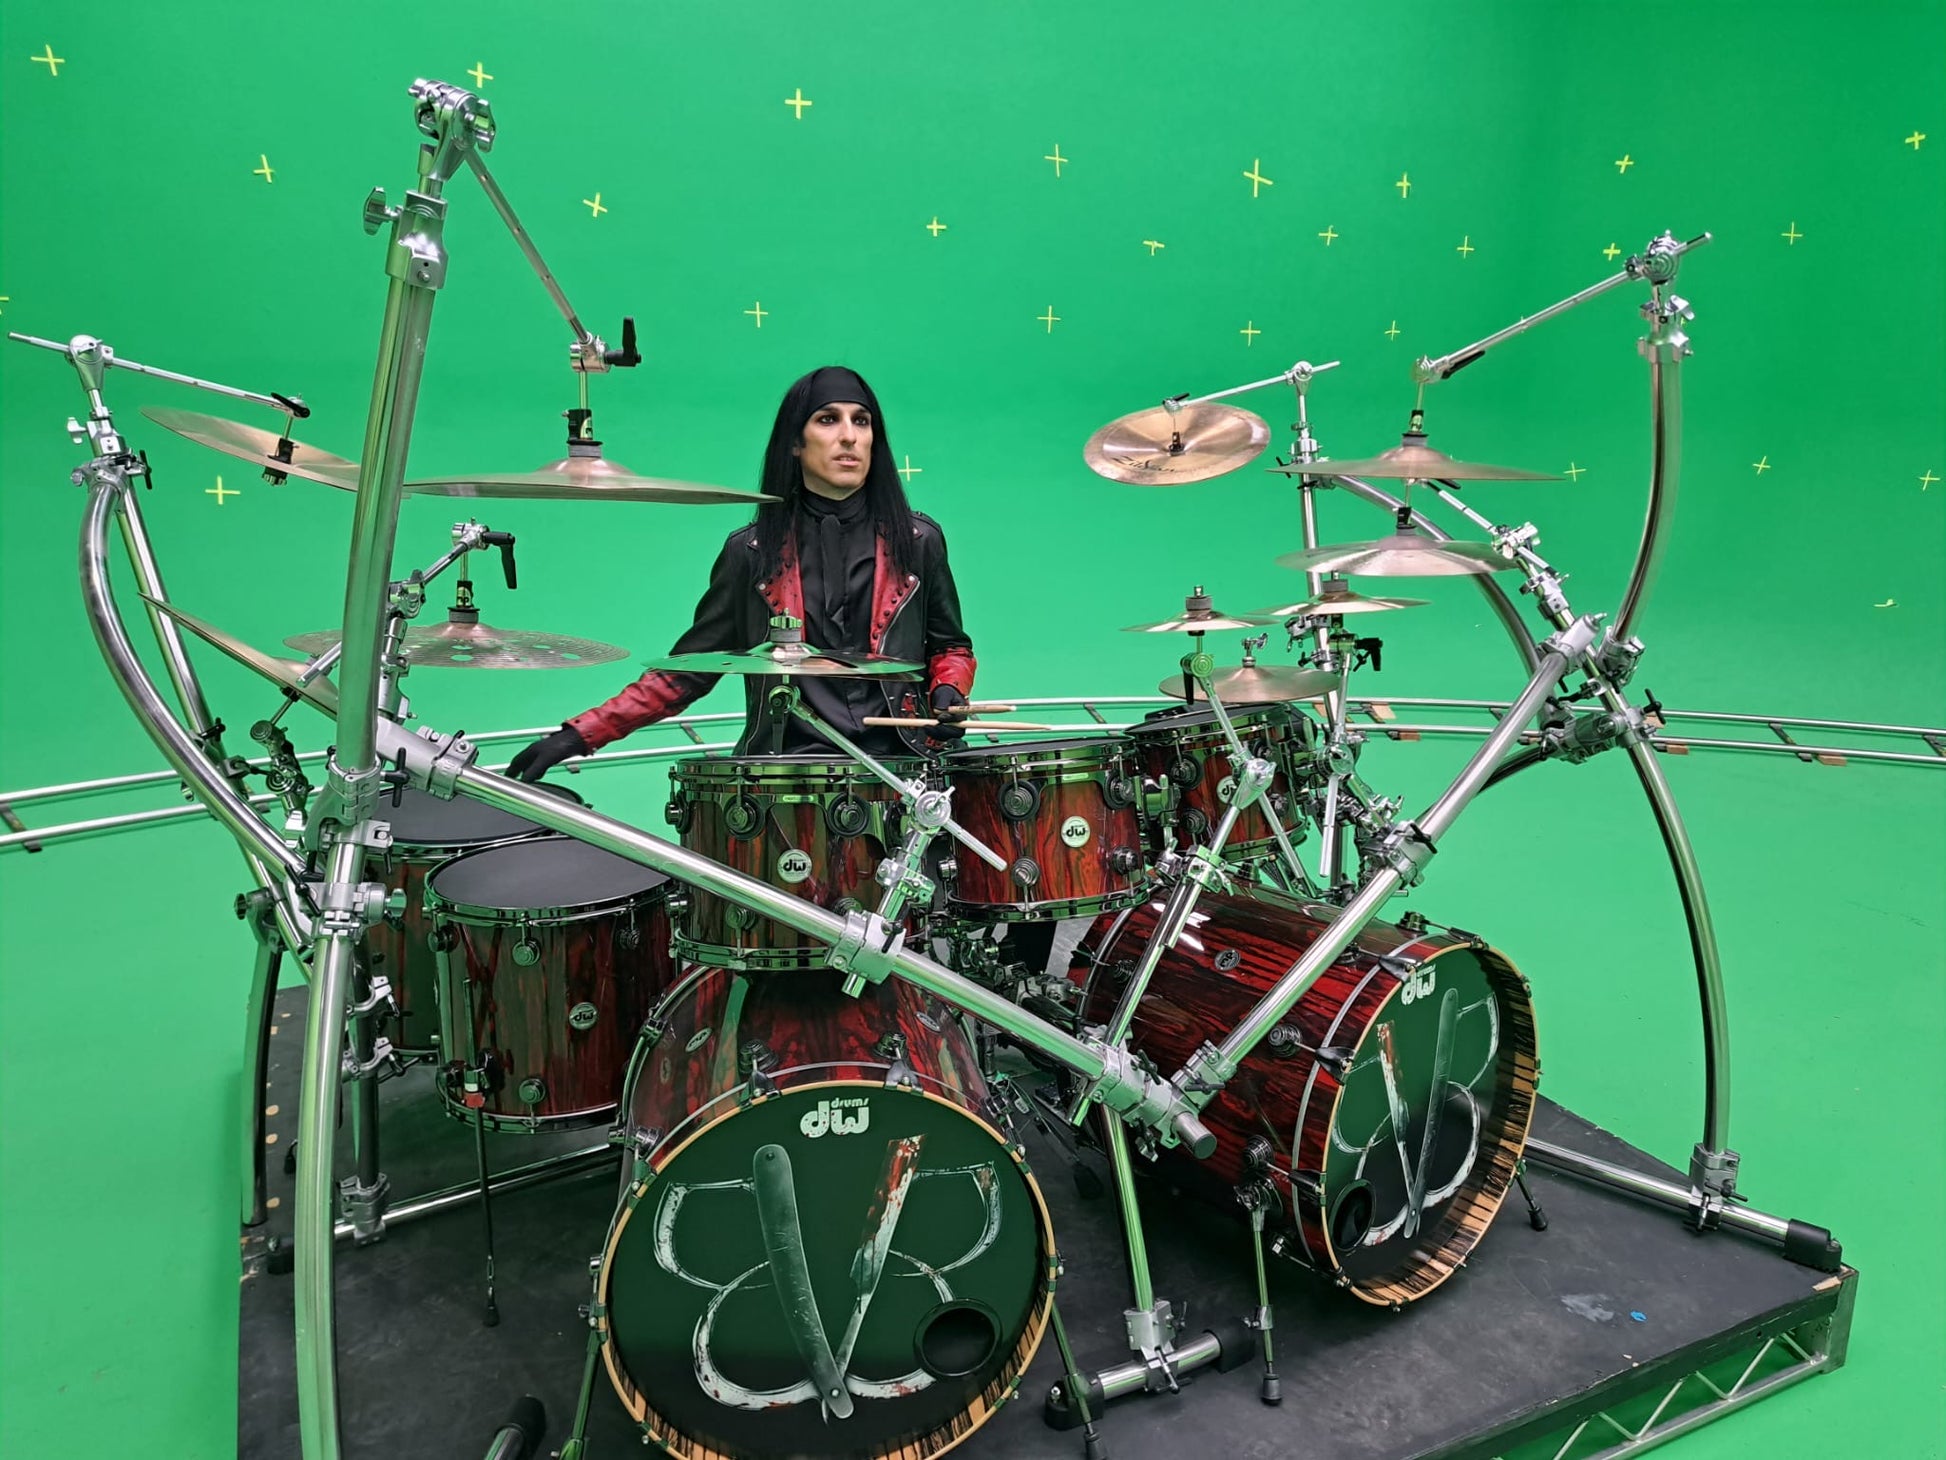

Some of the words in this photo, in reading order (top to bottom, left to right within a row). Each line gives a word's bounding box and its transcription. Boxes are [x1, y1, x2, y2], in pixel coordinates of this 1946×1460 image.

[1065, 825, 1086, 838] dw
[782, 858, 807, 872] dw
[1400, 969, 1437, 1006] dw
[573, 1010, 595, 1022] dw
[830, 1096, 870, 1109] drums
[799, 1100, 870, 1139] dw
